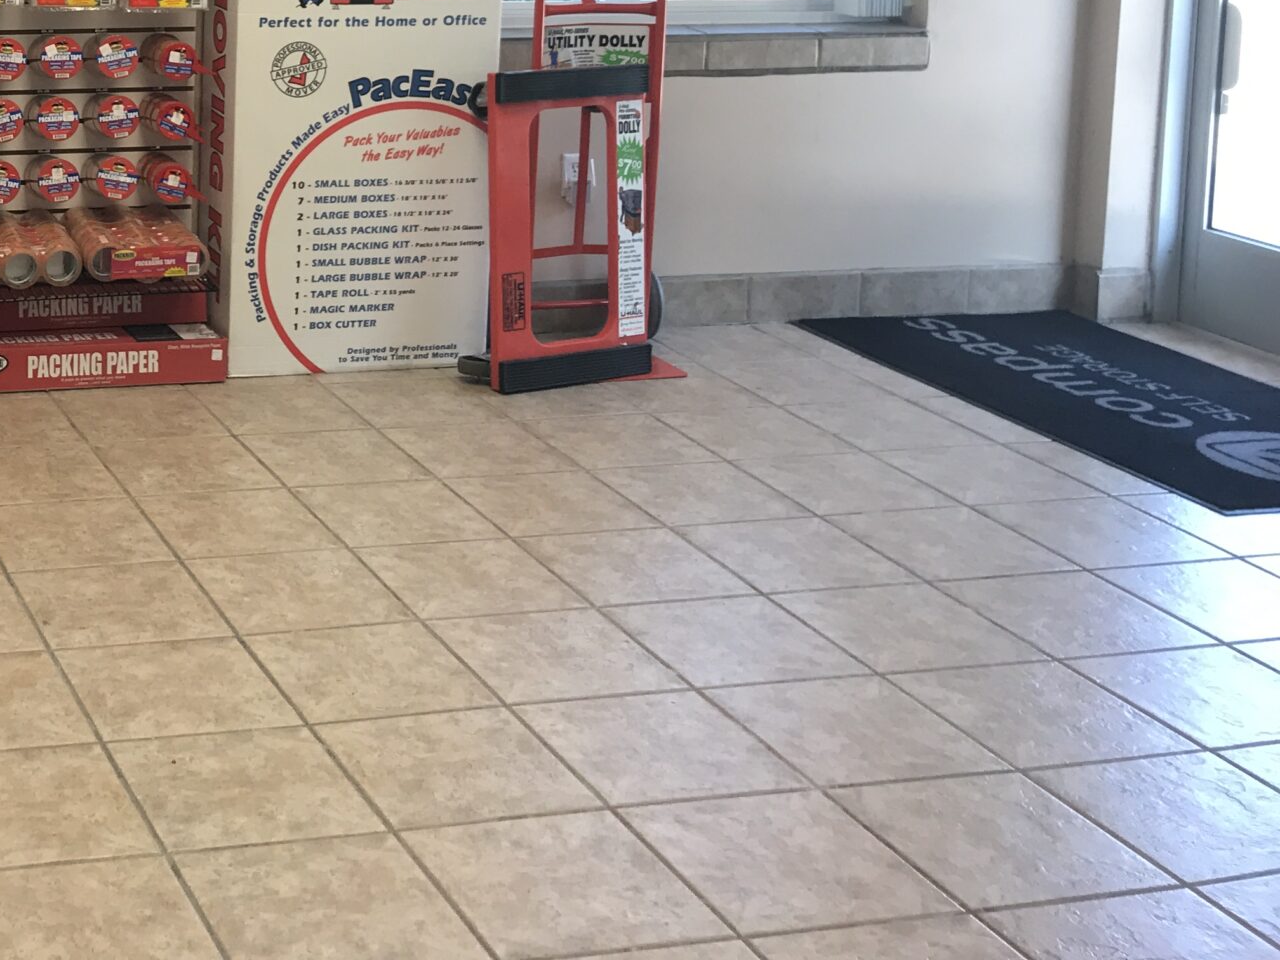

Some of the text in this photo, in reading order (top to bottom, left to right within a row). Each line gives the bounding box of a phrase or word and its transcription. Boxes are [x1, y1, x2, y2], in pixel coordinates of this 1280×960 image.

[258, 15, 487, 28] Perfect for the Home or Office
[548, 34, 646, 49] UTILITY DOLLY
[273, 42, 320, 68] PROFESSIONAL
[275, 61, 324, 78] APPROVED
[284, 80, 321, 97] MOVER
[619, 120, 641, 134] DOLLY
[343, 125, 461, 147] Pack Your Valuables
[361, 142, 445, 162] the Easy Way!
[314, 178, 388, 188] SMALL BOXES
[314, 194, 395, 204] MEDIUM BOXES
[245, 102, 351, 323] Packing & Storage Products Made Easy
[313, 224, 420, 236] GLASS PACKING KIT
[312, 240, 410, 251] DISH PACKING KIT
[311, 255, 427, 267] SMALL BUBBLE WRAP
[311, 288, 370, 298] TAPE ROLL
[309, 303, 395, 314] MAGIC MARKER
[309, 319, 377, 330] BOX CUTTER
[347, 343, 457, 355] Designed by Professionals
[350, 355, 370, 363] Save
[391, 353, 410, 361] Time
[413, 352, 429, 360] and
[431, 351, 459, 361] Money
[27, 354, 102, 378] PACKING
[107, 350, 159, 374] PAPER
[901, 318, 1193, 429] compass
[1156, 392, 1251, 422] SELF
